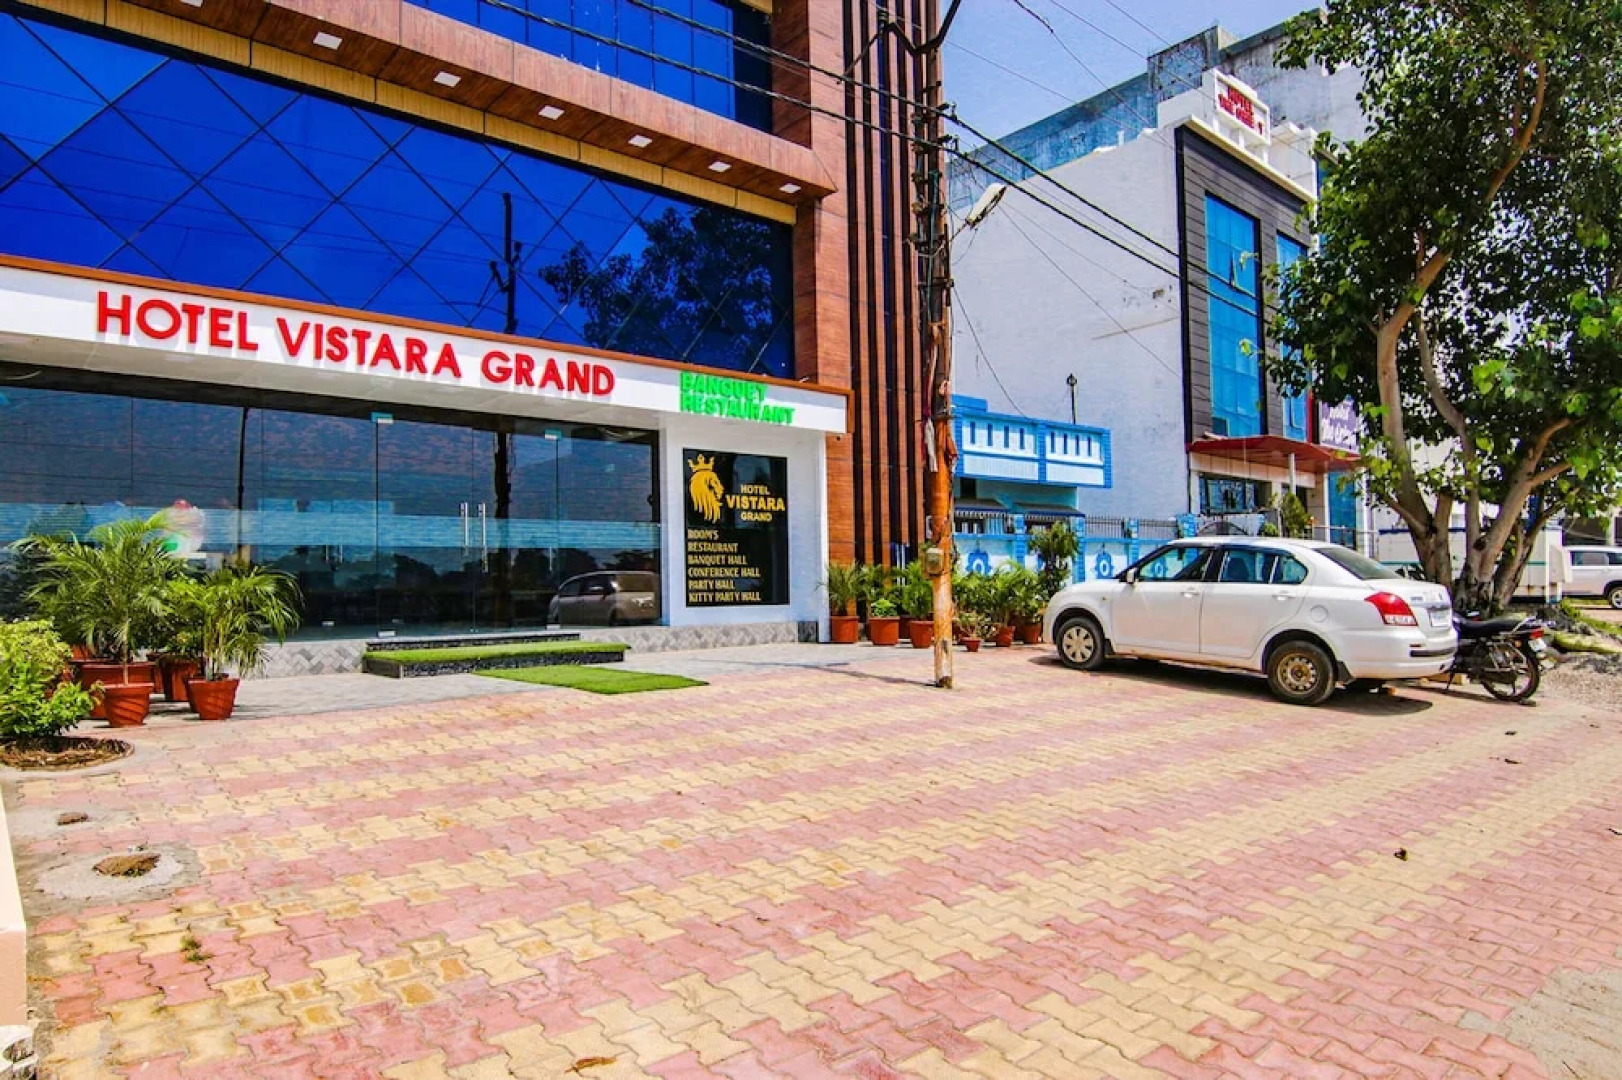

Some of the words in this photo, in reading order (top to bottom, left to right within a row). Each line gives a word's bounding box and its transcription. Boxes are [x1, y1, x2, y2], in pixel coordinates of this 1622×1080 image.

[96, 291, 258, 351] HOTEL
[276, 317, 462, 379] VISTARA
[480, 350, 615, 397] GRAND
[680, 369, 767, 403] BANQUET
[680, 391, 795, 424] RESTAURANT
[740, 484, 770, 495] HOTEL
[725, 494, 785, 511] VISTARA
[740, 511, 772, 521] GRAND
[687, 542, 738, 552] RESTAURANT
[687, 554, 726, 566] BANQUET
[727, 555, 748, 565] HALL
[688, 567, 739, 578] CONFERENCE
[741, 567, 761, 577] HALL
[688, 580, 714, 590] PARTY
[715, 580, 735, 590] HALL
[688, 592, 714, 602] KITTY
[715, 592, 740, 602] PARTY
[741, 592, 761, 601] HALL
